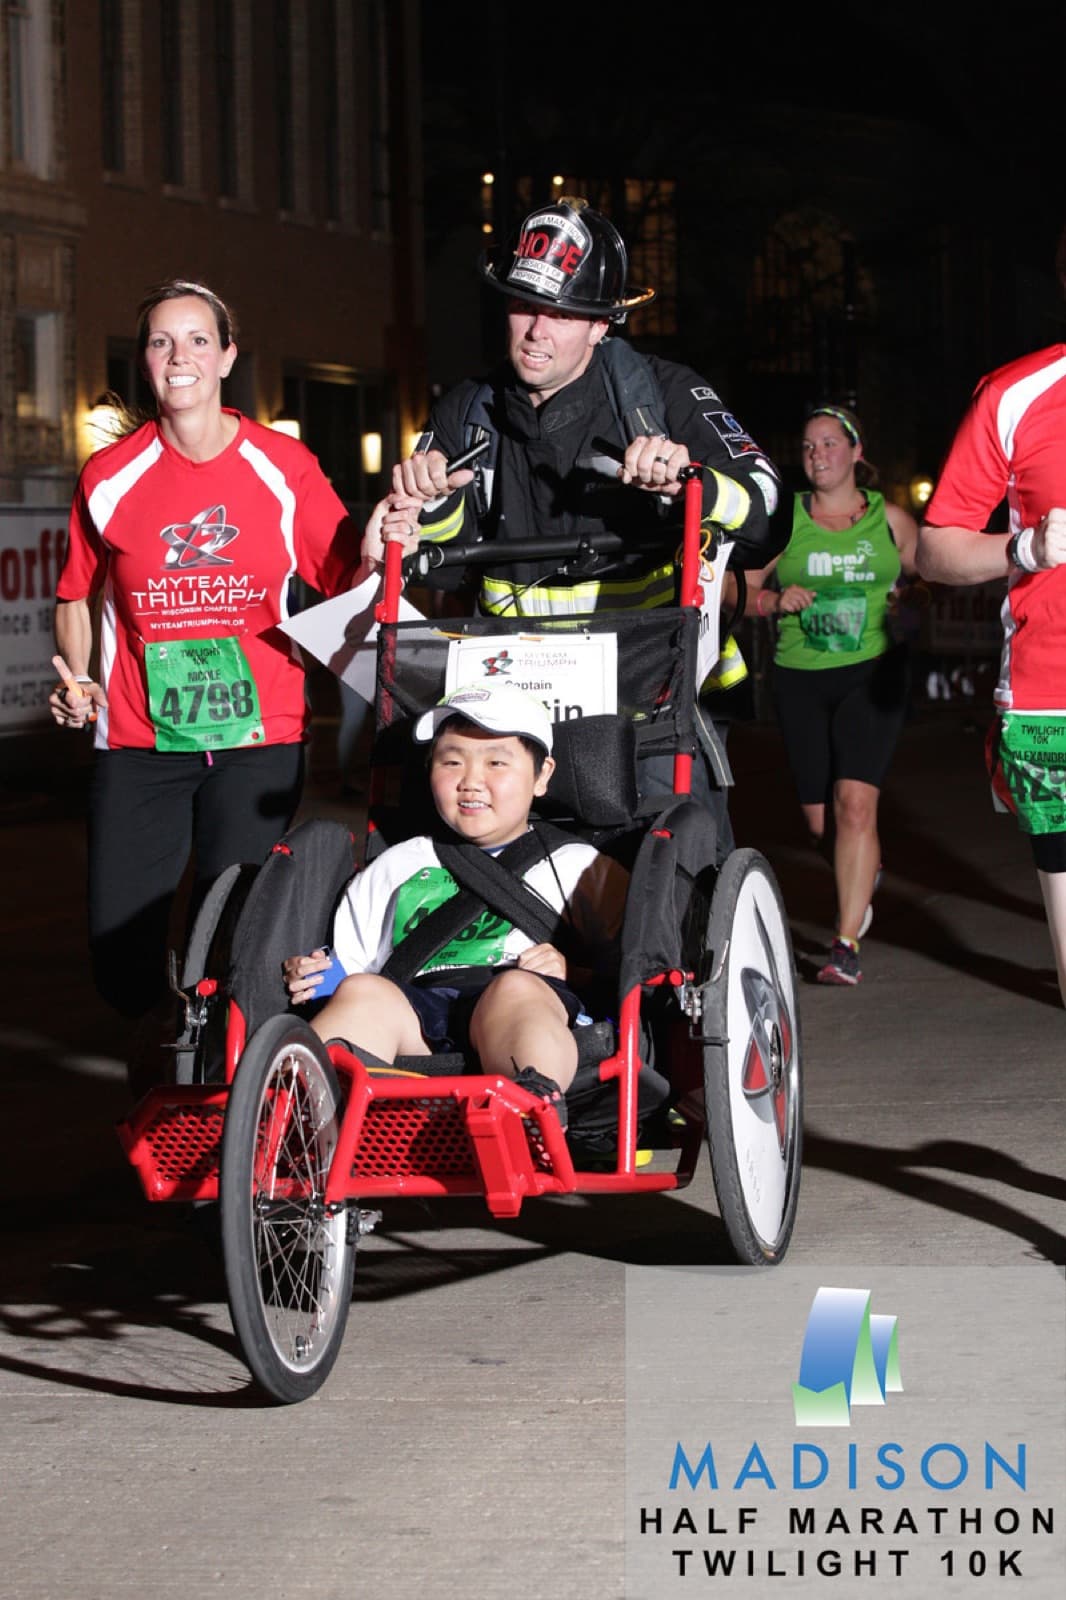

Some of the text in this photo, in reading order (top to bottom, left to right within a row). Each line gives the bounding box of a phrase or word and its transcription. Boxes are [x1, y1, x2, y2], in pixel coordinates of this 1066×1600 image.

[517, 231, 583, 275] HOPE
[147, 576, 249, 590] MYTEAM
[131, 588, 267, 608] TRIUMPH
[204, 605, 238, 613] CHAPTER
[517, 658, 577, 668] TRIUMPH
[160, 679, 254, 726] 4798
[1021, 725, 1066, 737] TWILIGHT
[1033, 736, 1049, 745] 10K
